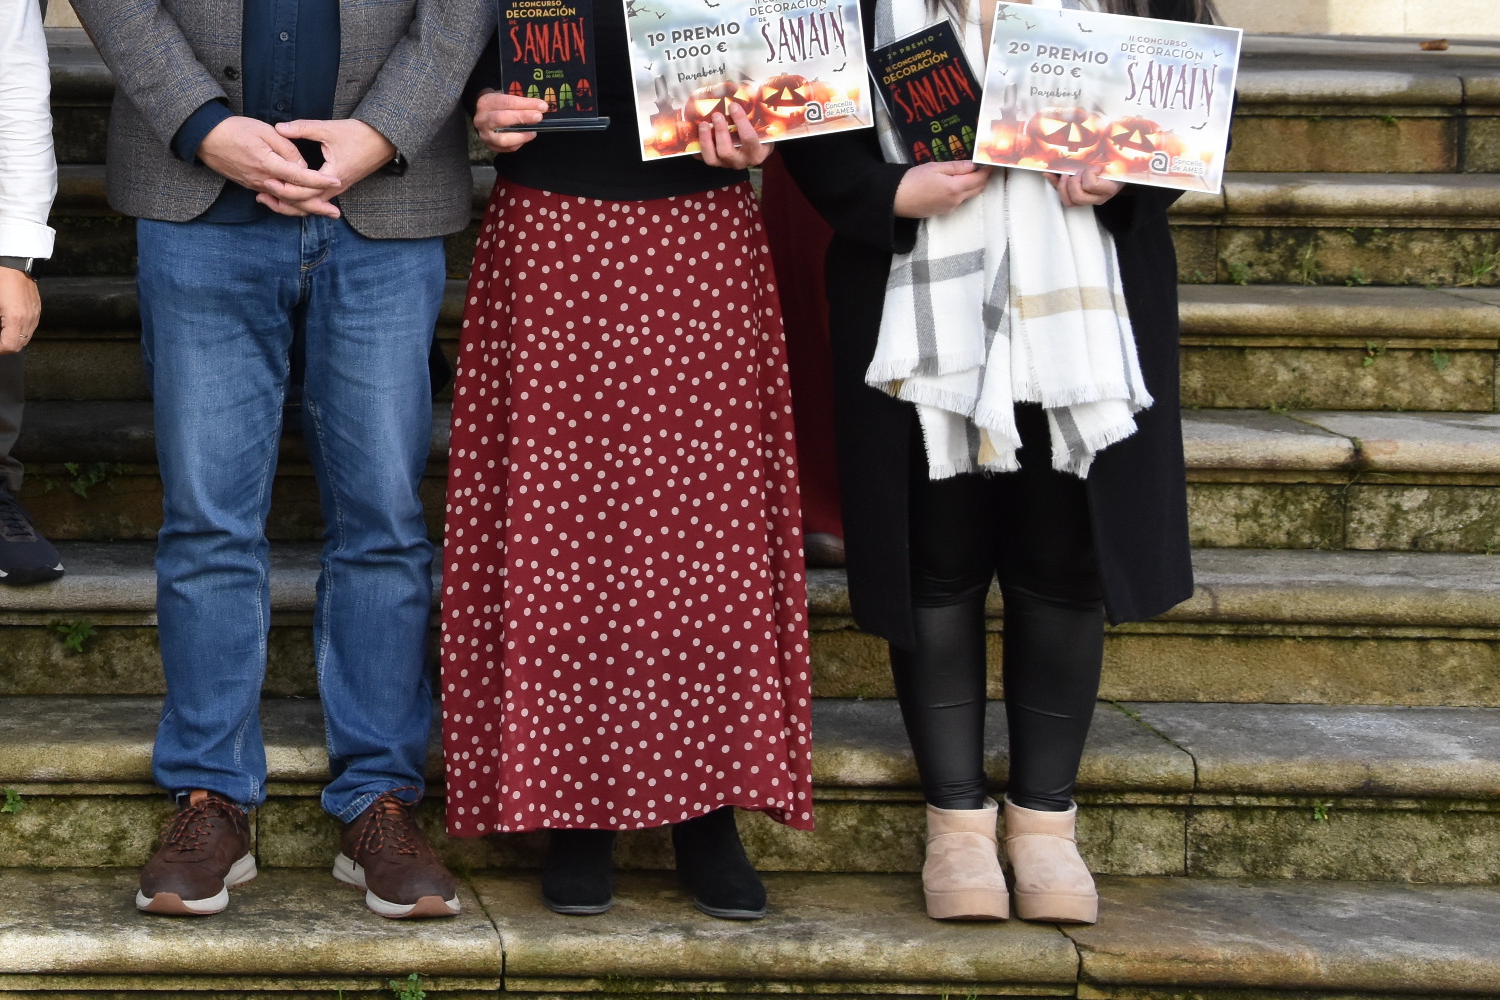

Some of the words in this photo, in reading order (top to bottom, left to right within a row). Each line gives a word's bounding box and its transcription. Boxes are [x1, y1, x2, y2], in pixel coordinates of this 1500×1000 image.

[506, 5, 576, 19] DECORACIÓN
[519, 0, 562, 8] CONCURSO
[672, 21, 741, 44] PREMIO
[899, 35, 934, 54] PREMIO
[1137, 36, 1188, 48] CONCURSO
[664, 43, 711, 61] 1.000
[716, 41, 728, 53] €
[1037, 44, 1109, 66] PREMIO
[1120, 42, 1204, 61] DECORACIÓN
[882, 50, 949, 85] DECORACIÓN
[892, 49, 932, 70] CONCURSO
[677, 64, 727, 83] Parabéns!
[1030, 62, 1065, 76] 600
[1070, 67, 1081, 78] €
[1030, 86, 1082, 100] Parabéns!
[825, 101, 853, 110] Concello
[826, 109, 835, 117] de
[835, 107, 855, 115] AMES
[1172, 164, 1182, 172] de
[1182, 166, 1204, 175] AMES
[1173, 157, 1203, 168] Concello
